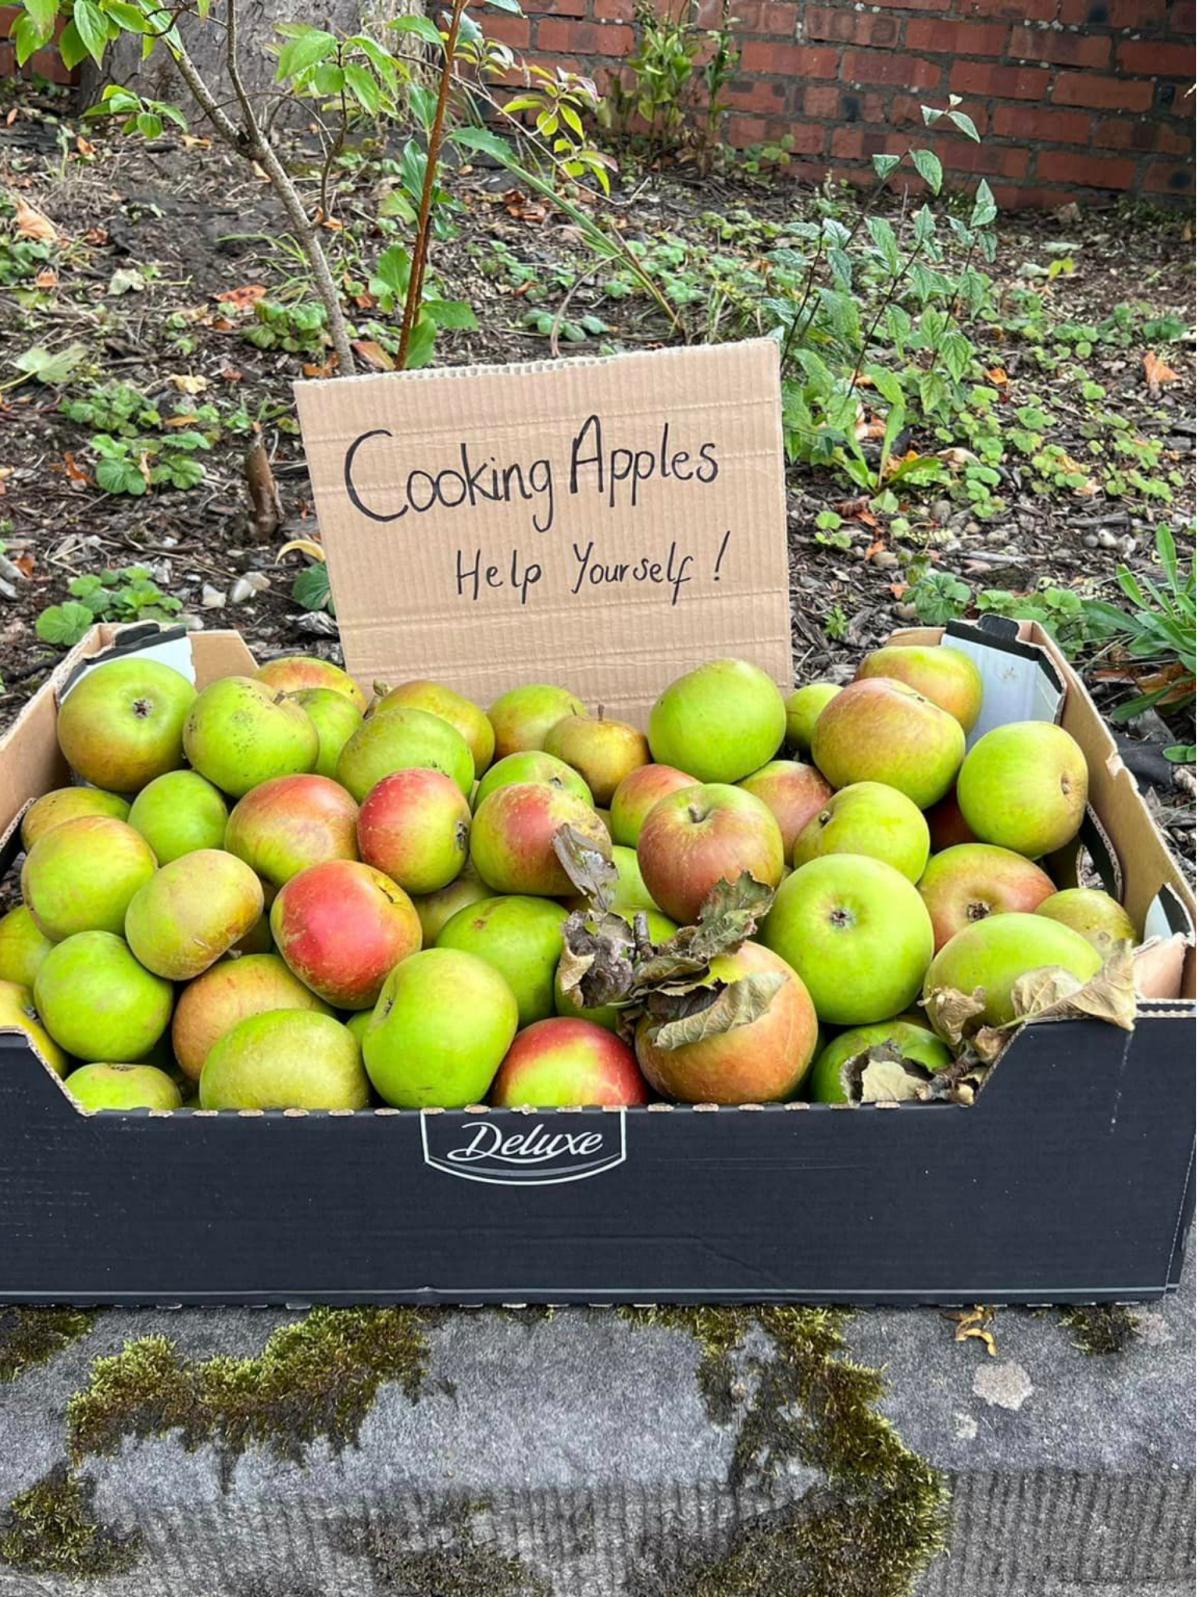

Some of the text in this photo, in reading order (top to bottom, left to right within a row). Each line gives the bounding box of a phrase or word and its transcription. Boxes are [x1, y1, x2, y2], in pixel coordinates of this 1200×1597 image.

[344, 414, 719, 532] Cooking Apples
[455, 549, 543, 604] Help
[447, 1121, 603, 1164] Deluxe
